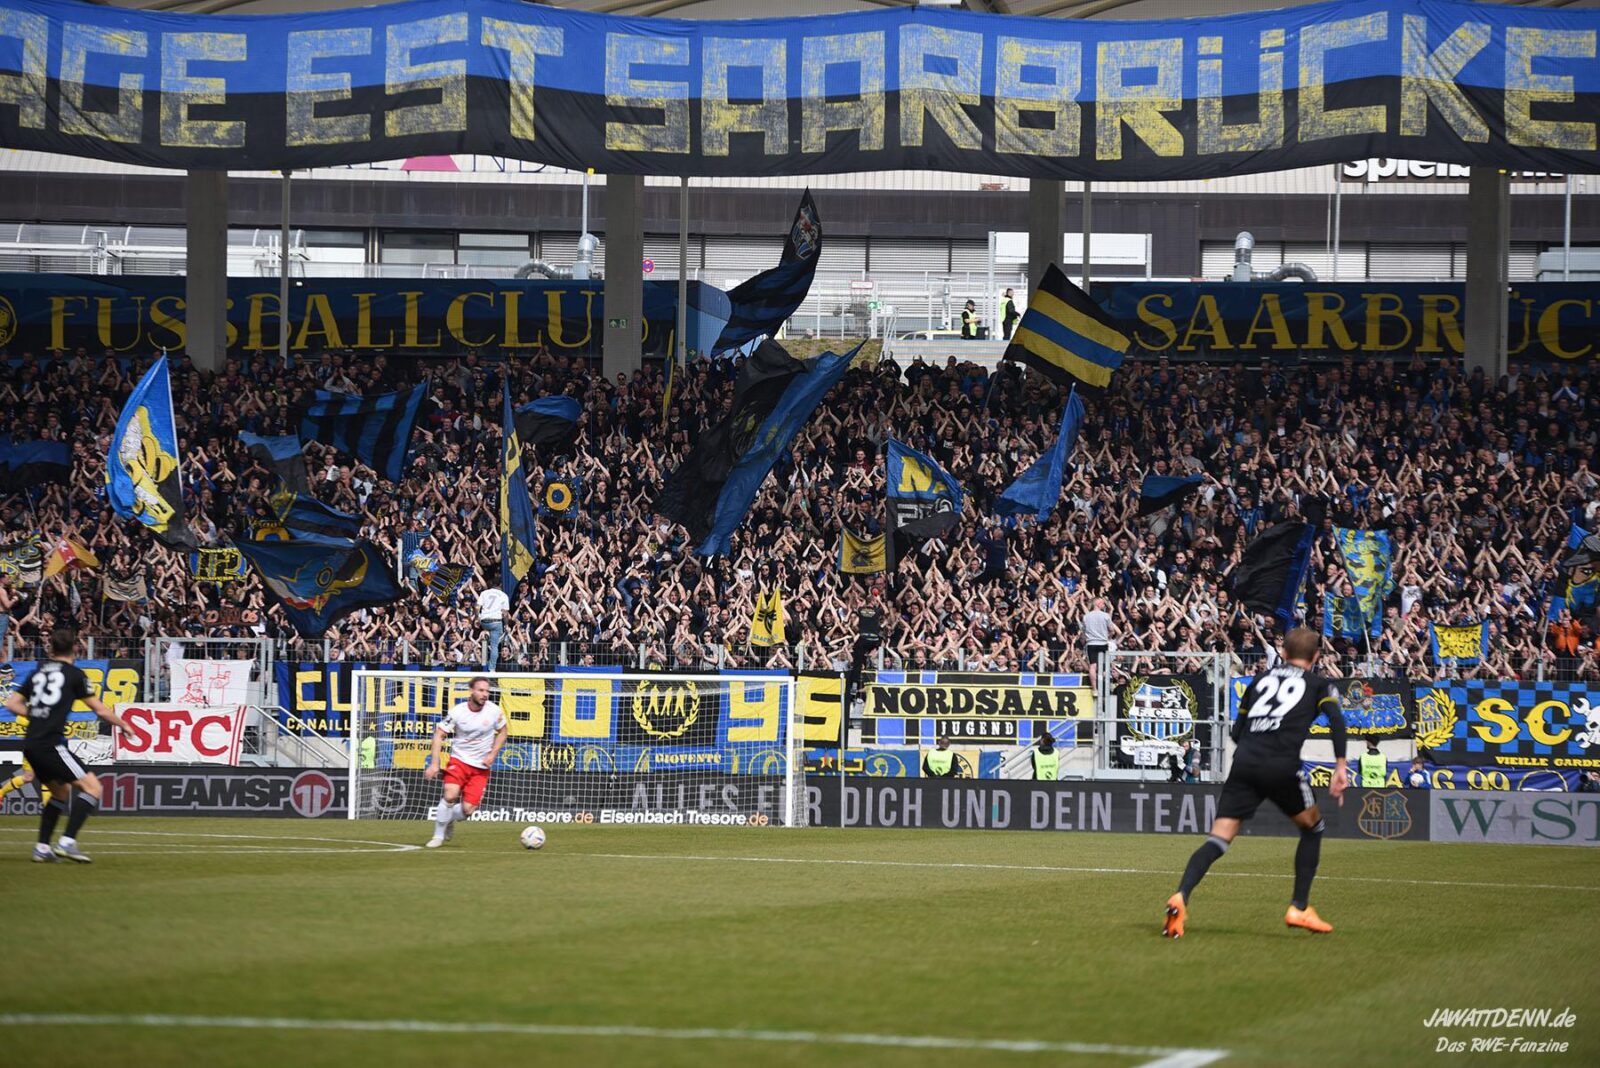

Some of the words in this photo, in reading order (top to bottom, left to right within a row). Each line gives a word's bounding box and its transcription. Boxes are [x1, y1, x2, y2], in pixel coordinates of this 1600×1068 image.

[285, 12, 564, 147] EST
[604, 10, 1597, 161] SAARBRÜCKE
[30, 671, 65, 706] 33
[871, 686, 1079, 716] NORDSAAR
[1247, 675, 1307, 718] 29
[118, 708, 233, 758] SFC
[286, 717, 359, 730] CANAILL
[940, 720, 1015, 736] JUGEND
[1138, 751, 1153, 763] E3
[1494, 756, 1549, 767] VIEILLE
[1553, 758, 1600, 768] GARDE
[600, 809, 680, 825] Eisenbach
[687, 811, 769, 826] Tresore.de
[845, 786, 922, 828] DICH
[941, 789, 1011, 829] UND
[1030, 791, 1111, 832] DEIN
